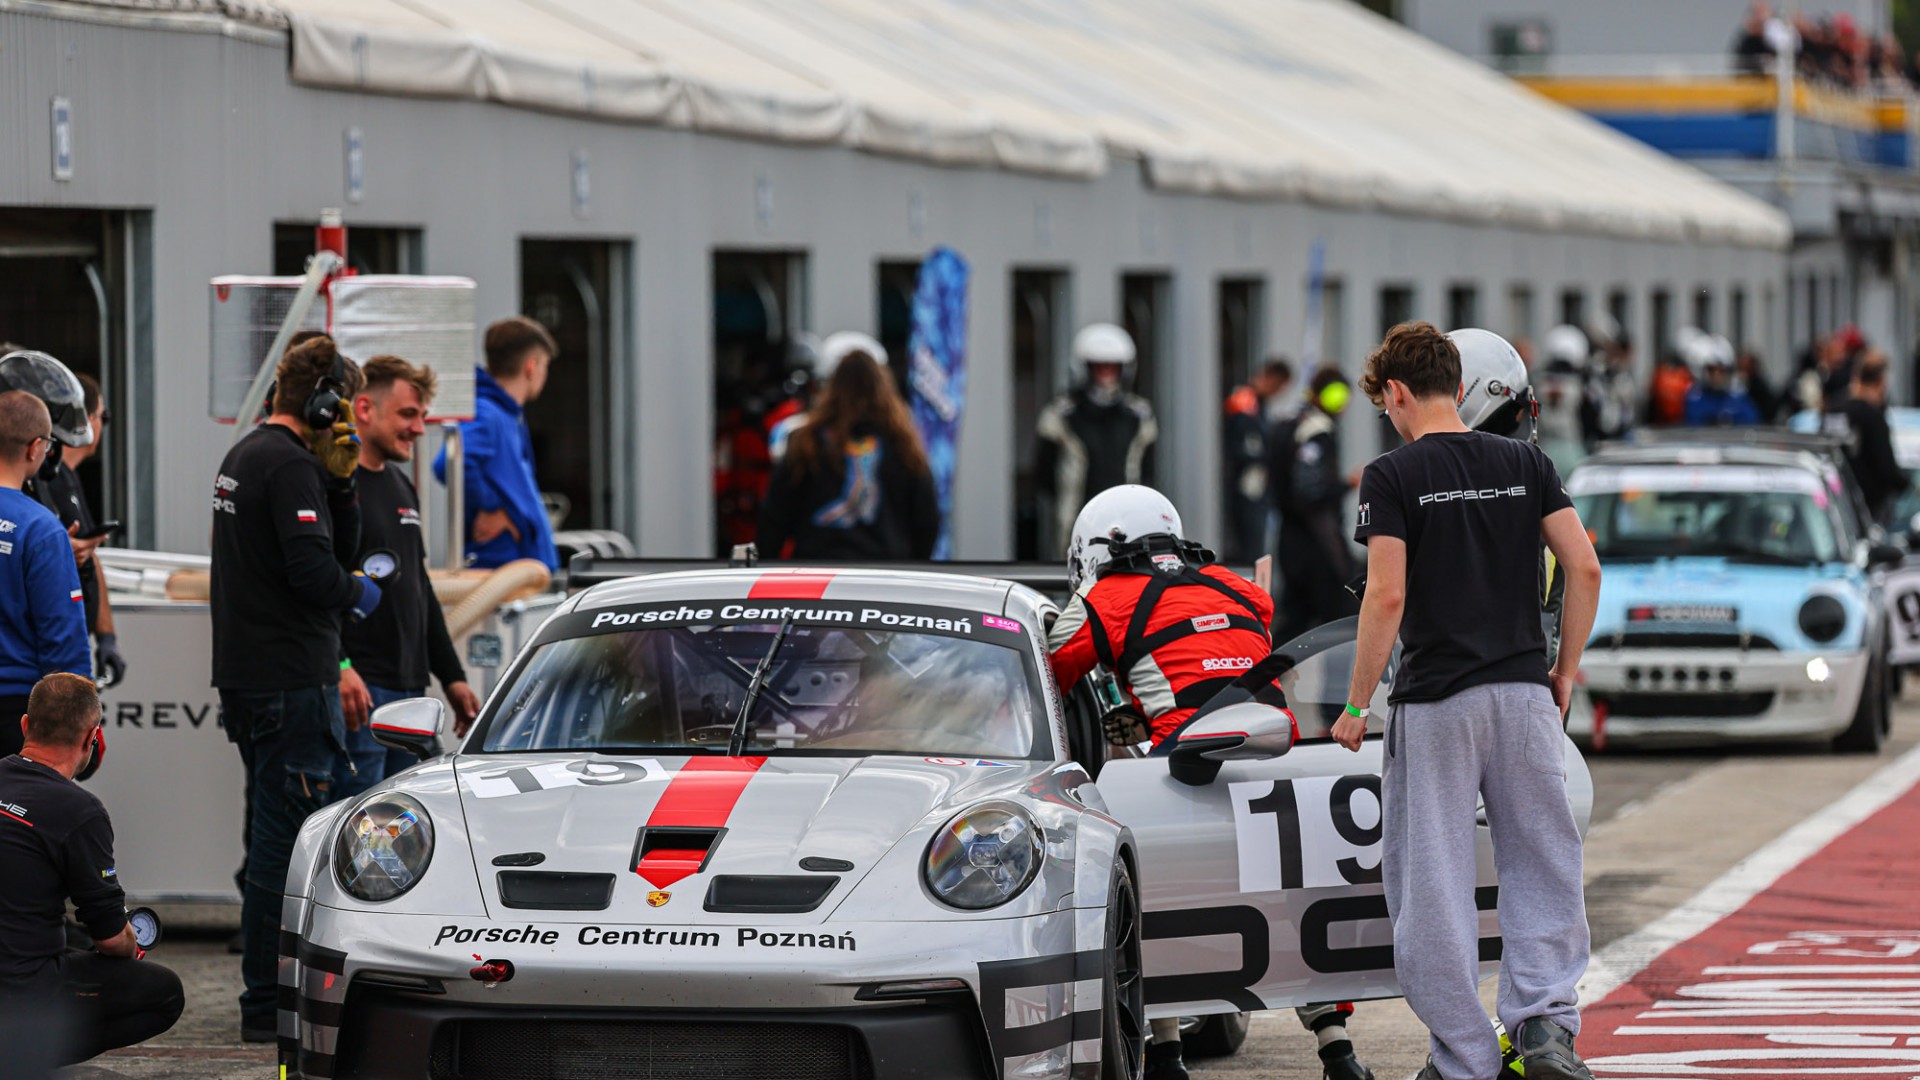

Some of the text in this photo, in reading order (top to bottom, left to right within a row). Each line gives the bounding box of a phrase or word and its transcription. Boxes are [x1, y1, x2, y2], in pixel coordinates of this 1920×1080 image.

[1418, 485, 1527, 506] PORSCHE
[591, 606, 713, 628] Porsche
[720, 605, 854, 622] Centrum
[860, 609, 973, 634] Poznań
[1195, 617, 1226, 628] SIMPSON
[480, 759, 648, 794] 19
[1247, 774, 1384, 890] 19
[434, 924, 856, 951] Porsche Centrum Poznań
